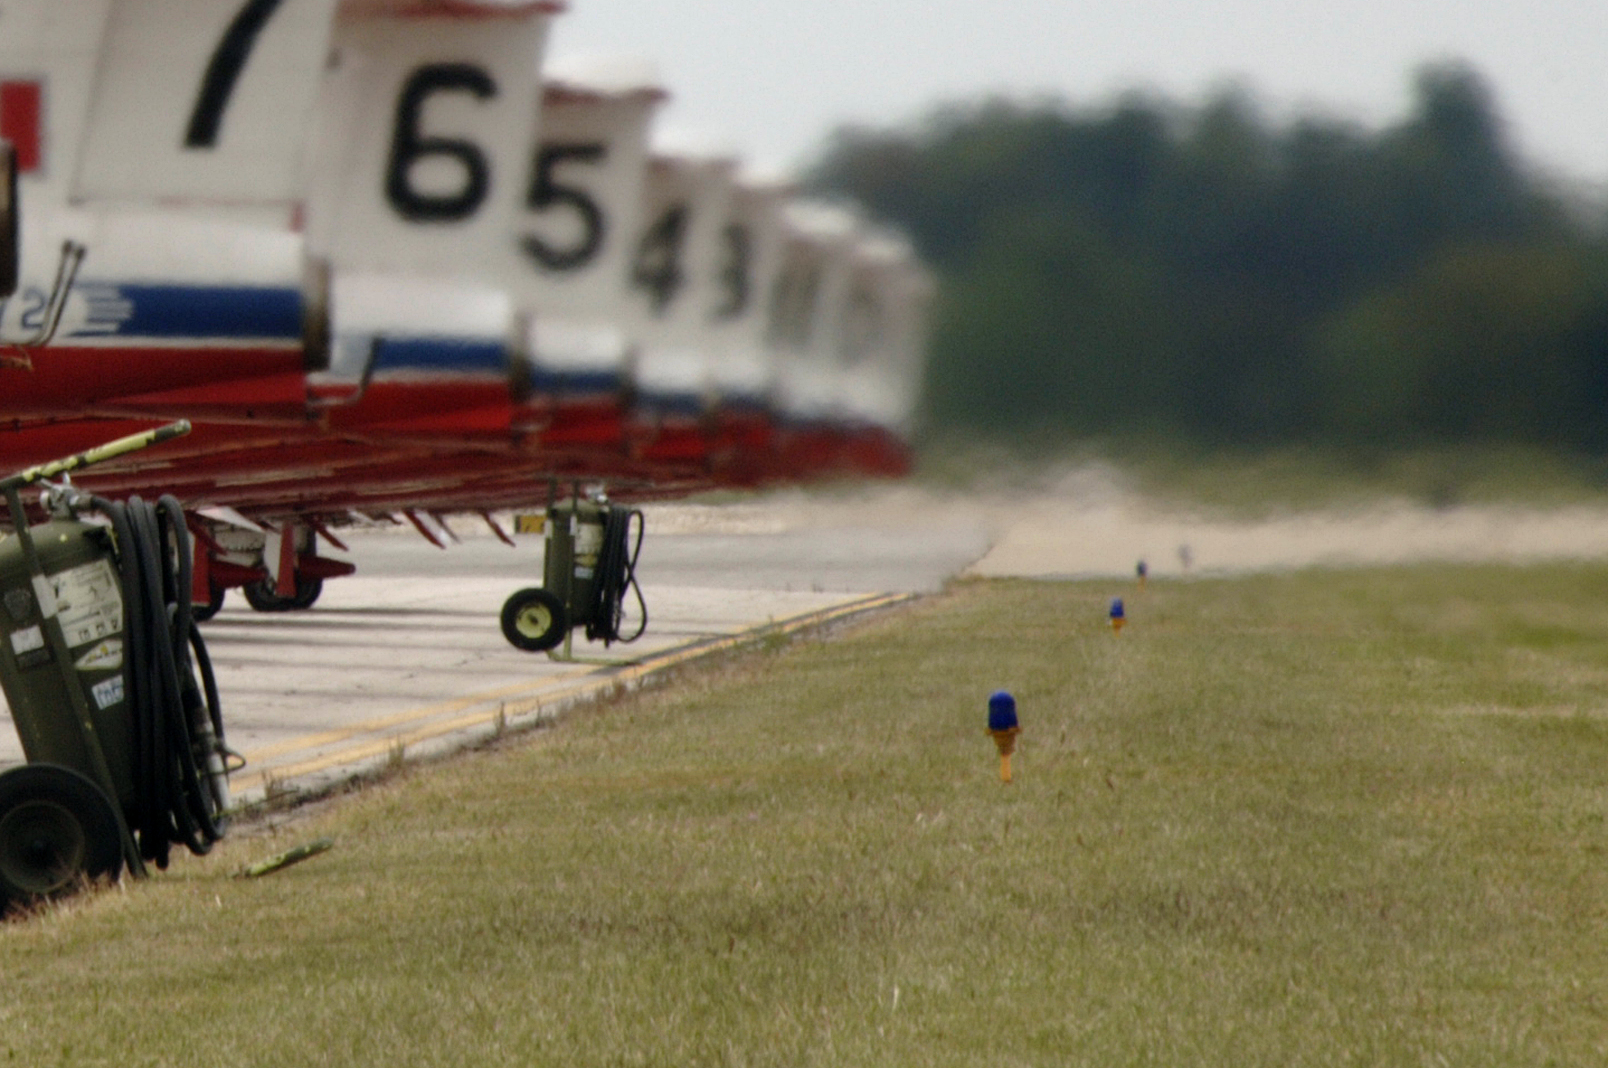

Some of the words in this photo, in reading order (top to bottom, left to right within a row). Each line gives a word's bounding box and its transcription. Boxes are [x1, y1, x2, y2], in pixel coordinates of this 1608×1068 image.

[383, 62, 498, 223] 6
[522, 143, 609, 273] 5
[629, 196, 690, 320] 4
